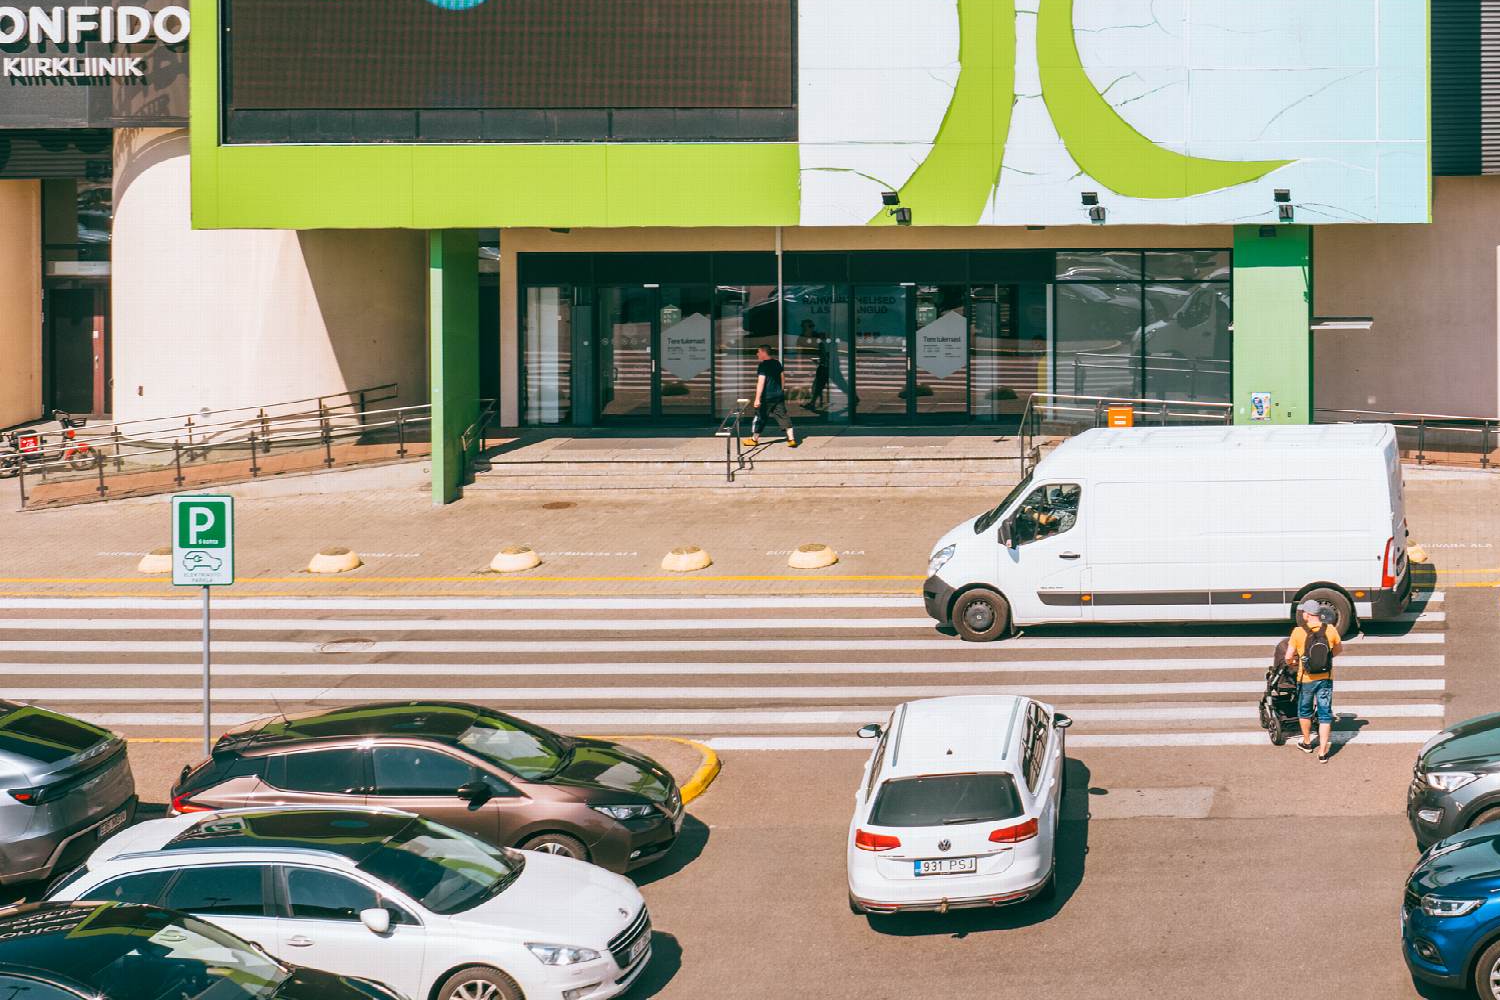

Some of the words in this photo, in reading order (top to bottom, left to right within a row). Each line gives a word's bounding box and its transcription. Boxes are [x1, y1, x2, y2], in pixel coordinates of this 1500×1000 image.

[3, 57, 144, 77] KIIRKLIINIK
[189, 506, 215, 545] P
[923, 860, 943, 873] 931
[949, 858, 974, 870] PSJ
